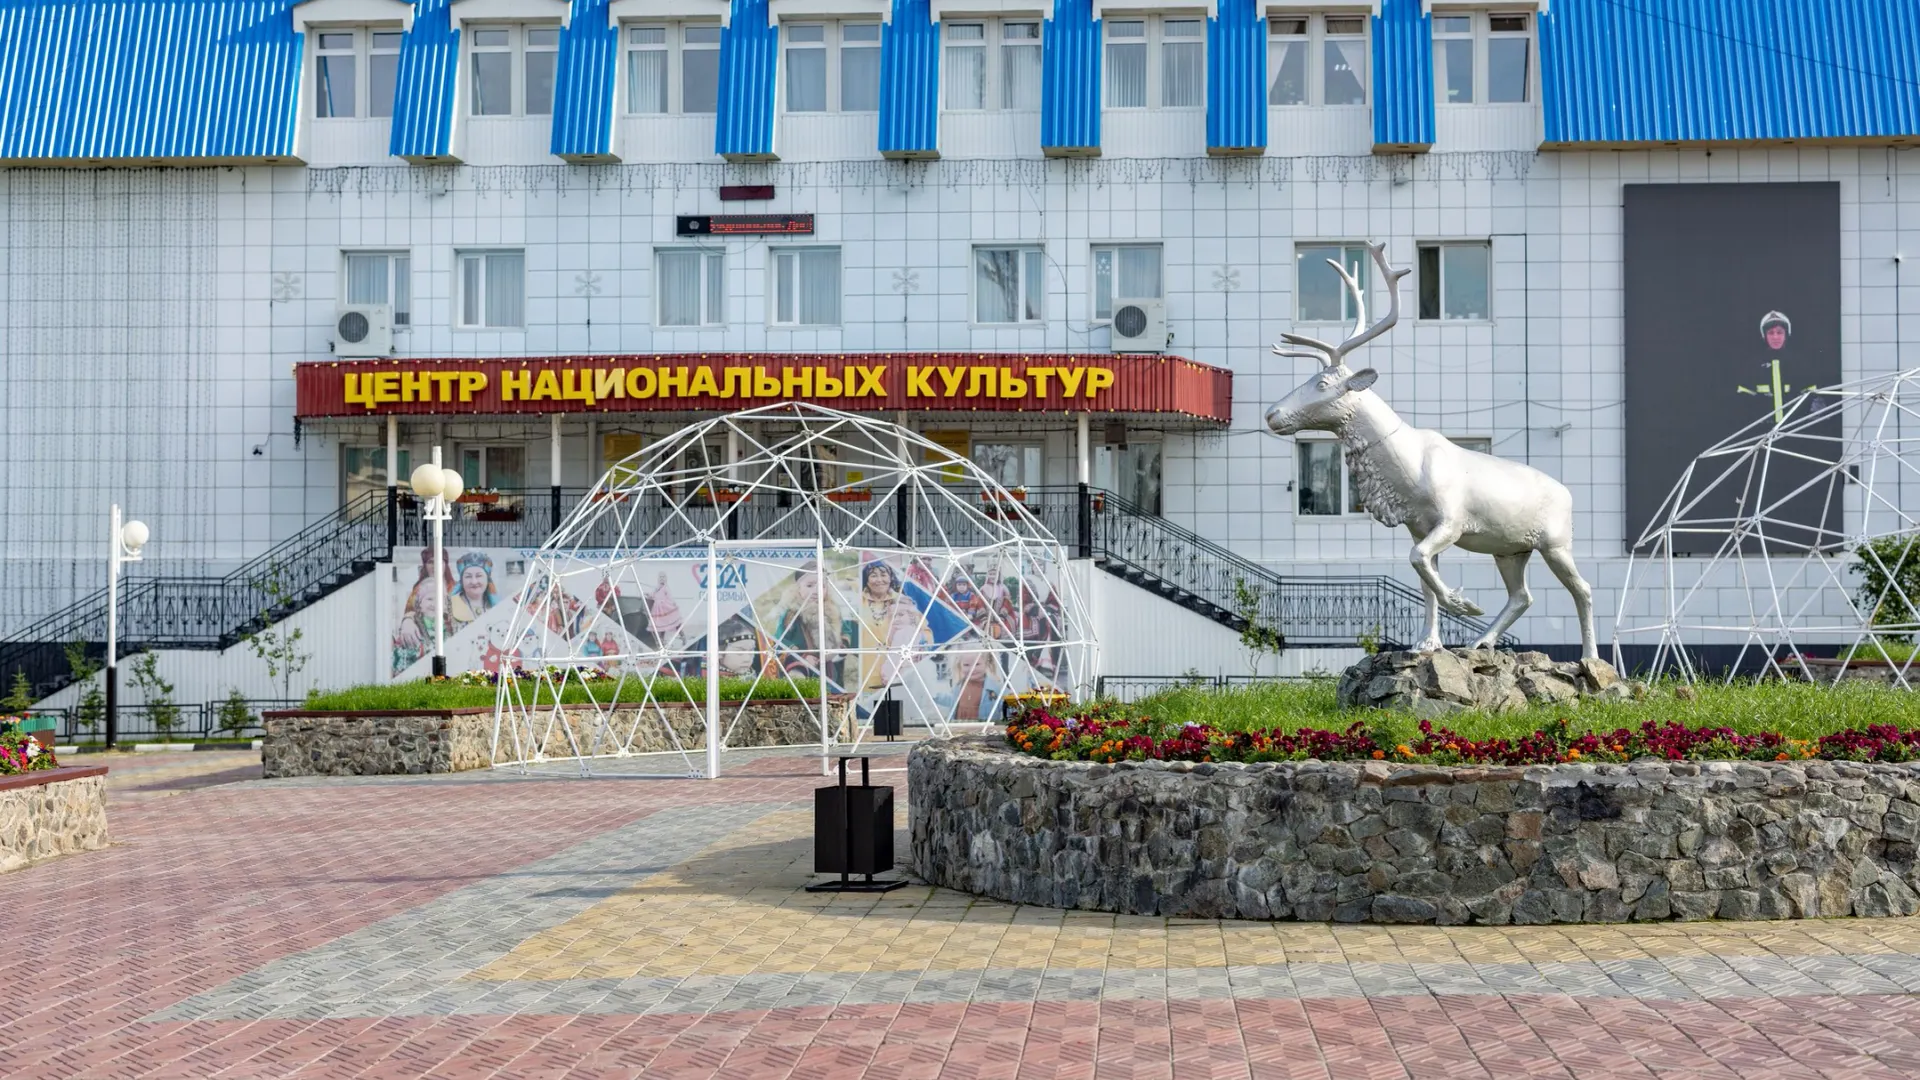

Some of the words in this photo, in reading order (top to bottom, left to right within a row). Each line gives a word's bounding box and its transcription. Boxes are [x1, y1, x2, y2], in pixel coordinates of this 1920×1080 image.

[344, 371, 487, 409] ЦЕНТР
[502, 366, 888, 406] НАЦИОНАЛЬНЫХ
[907, 366, 1114, 398] КУЛЬТУР
[700, 563, 748, 588] 2024
